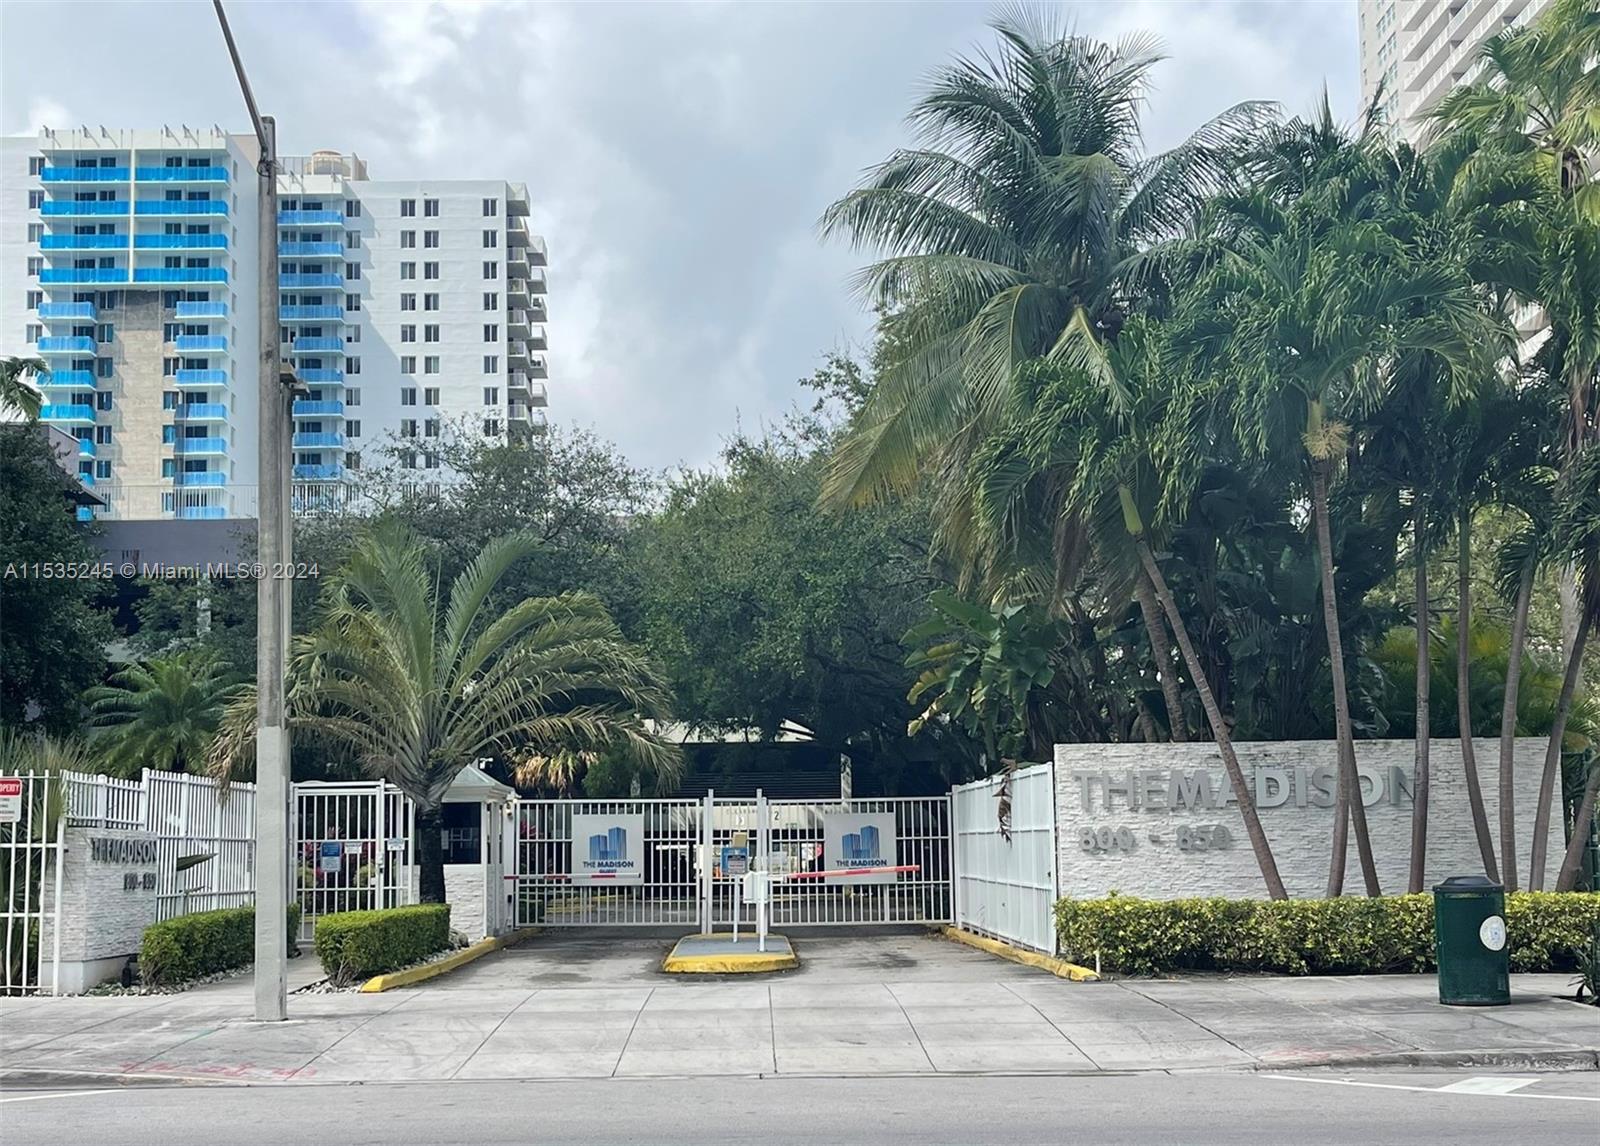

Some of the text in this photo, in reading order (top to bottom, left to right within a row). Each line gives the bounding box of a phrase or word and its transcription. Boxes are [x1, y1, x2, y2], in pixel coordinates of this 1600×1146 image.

[1079, 825, 1136, 852] 800
[1176, 824, 1233, 851] 850
[850, 859, 888, 867] MADISON
